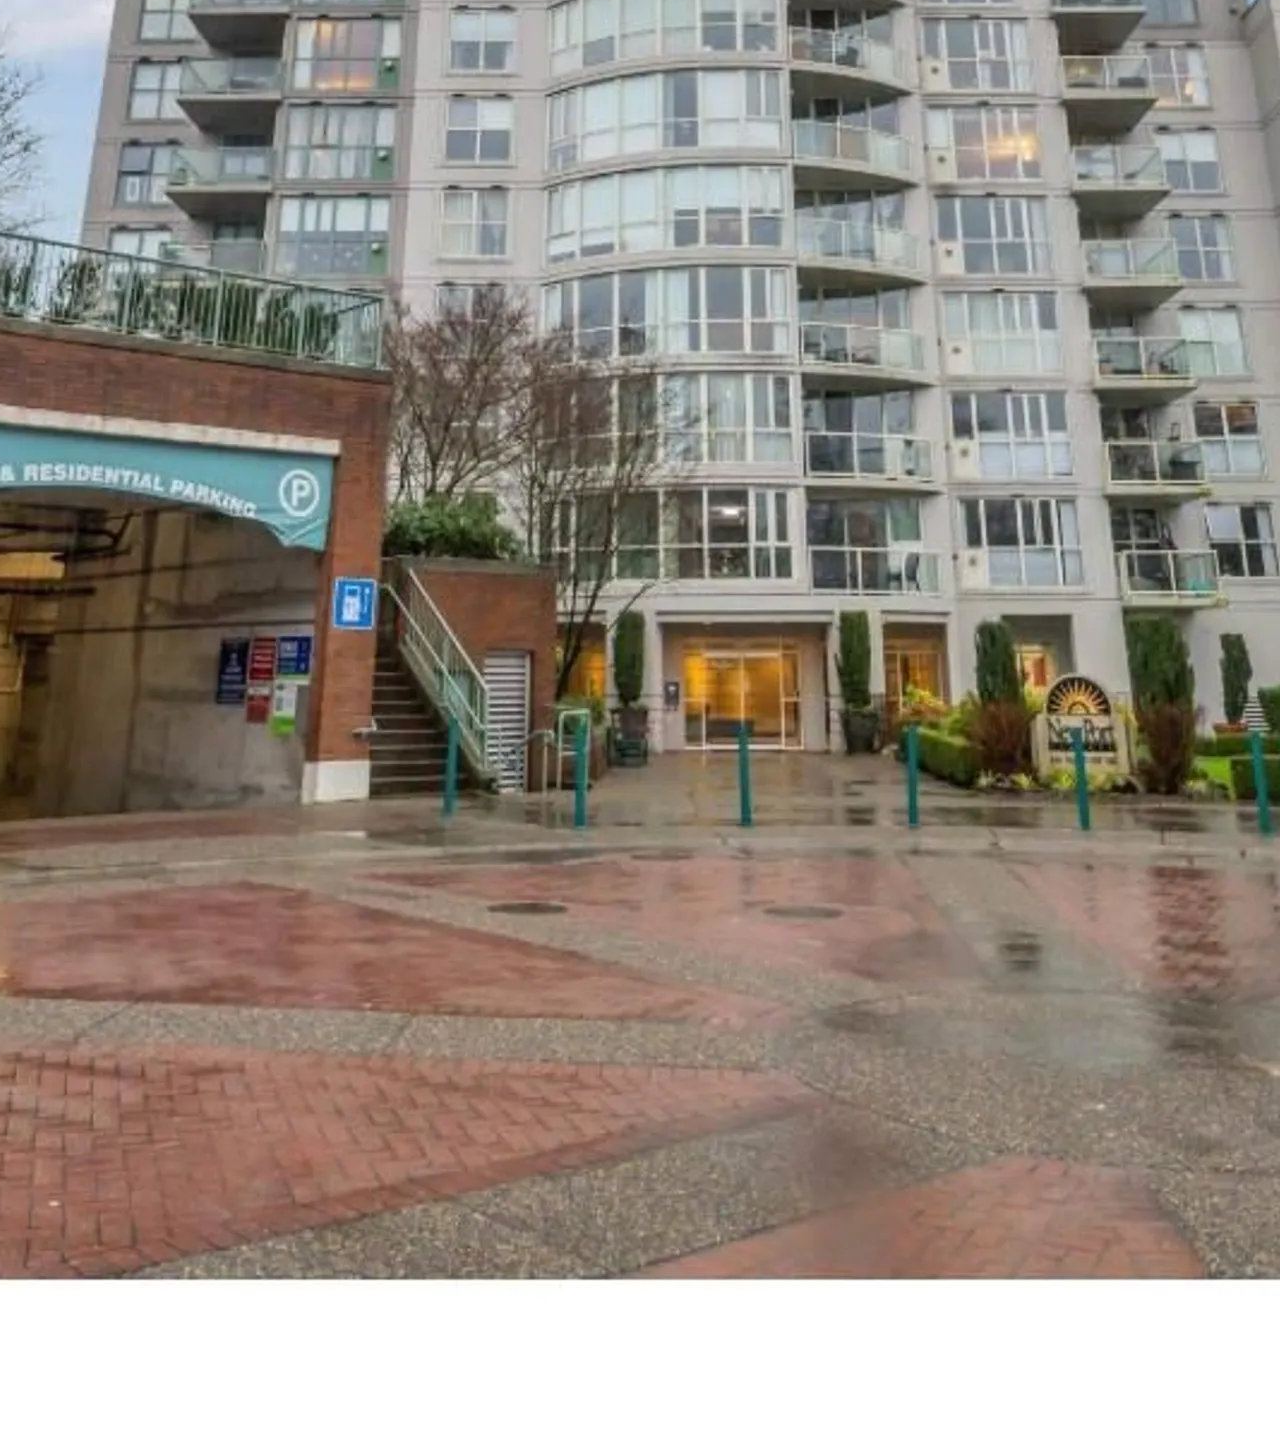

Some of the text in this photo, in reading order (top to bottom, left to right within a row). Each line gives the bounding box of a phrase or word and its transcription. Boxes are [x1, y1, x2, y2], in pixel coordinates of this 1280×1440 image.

[0, 463, 15, 482] &
[23, 461, 165, 493] RESIDENTIAL
[169, 477, 258, 518] PARKING
